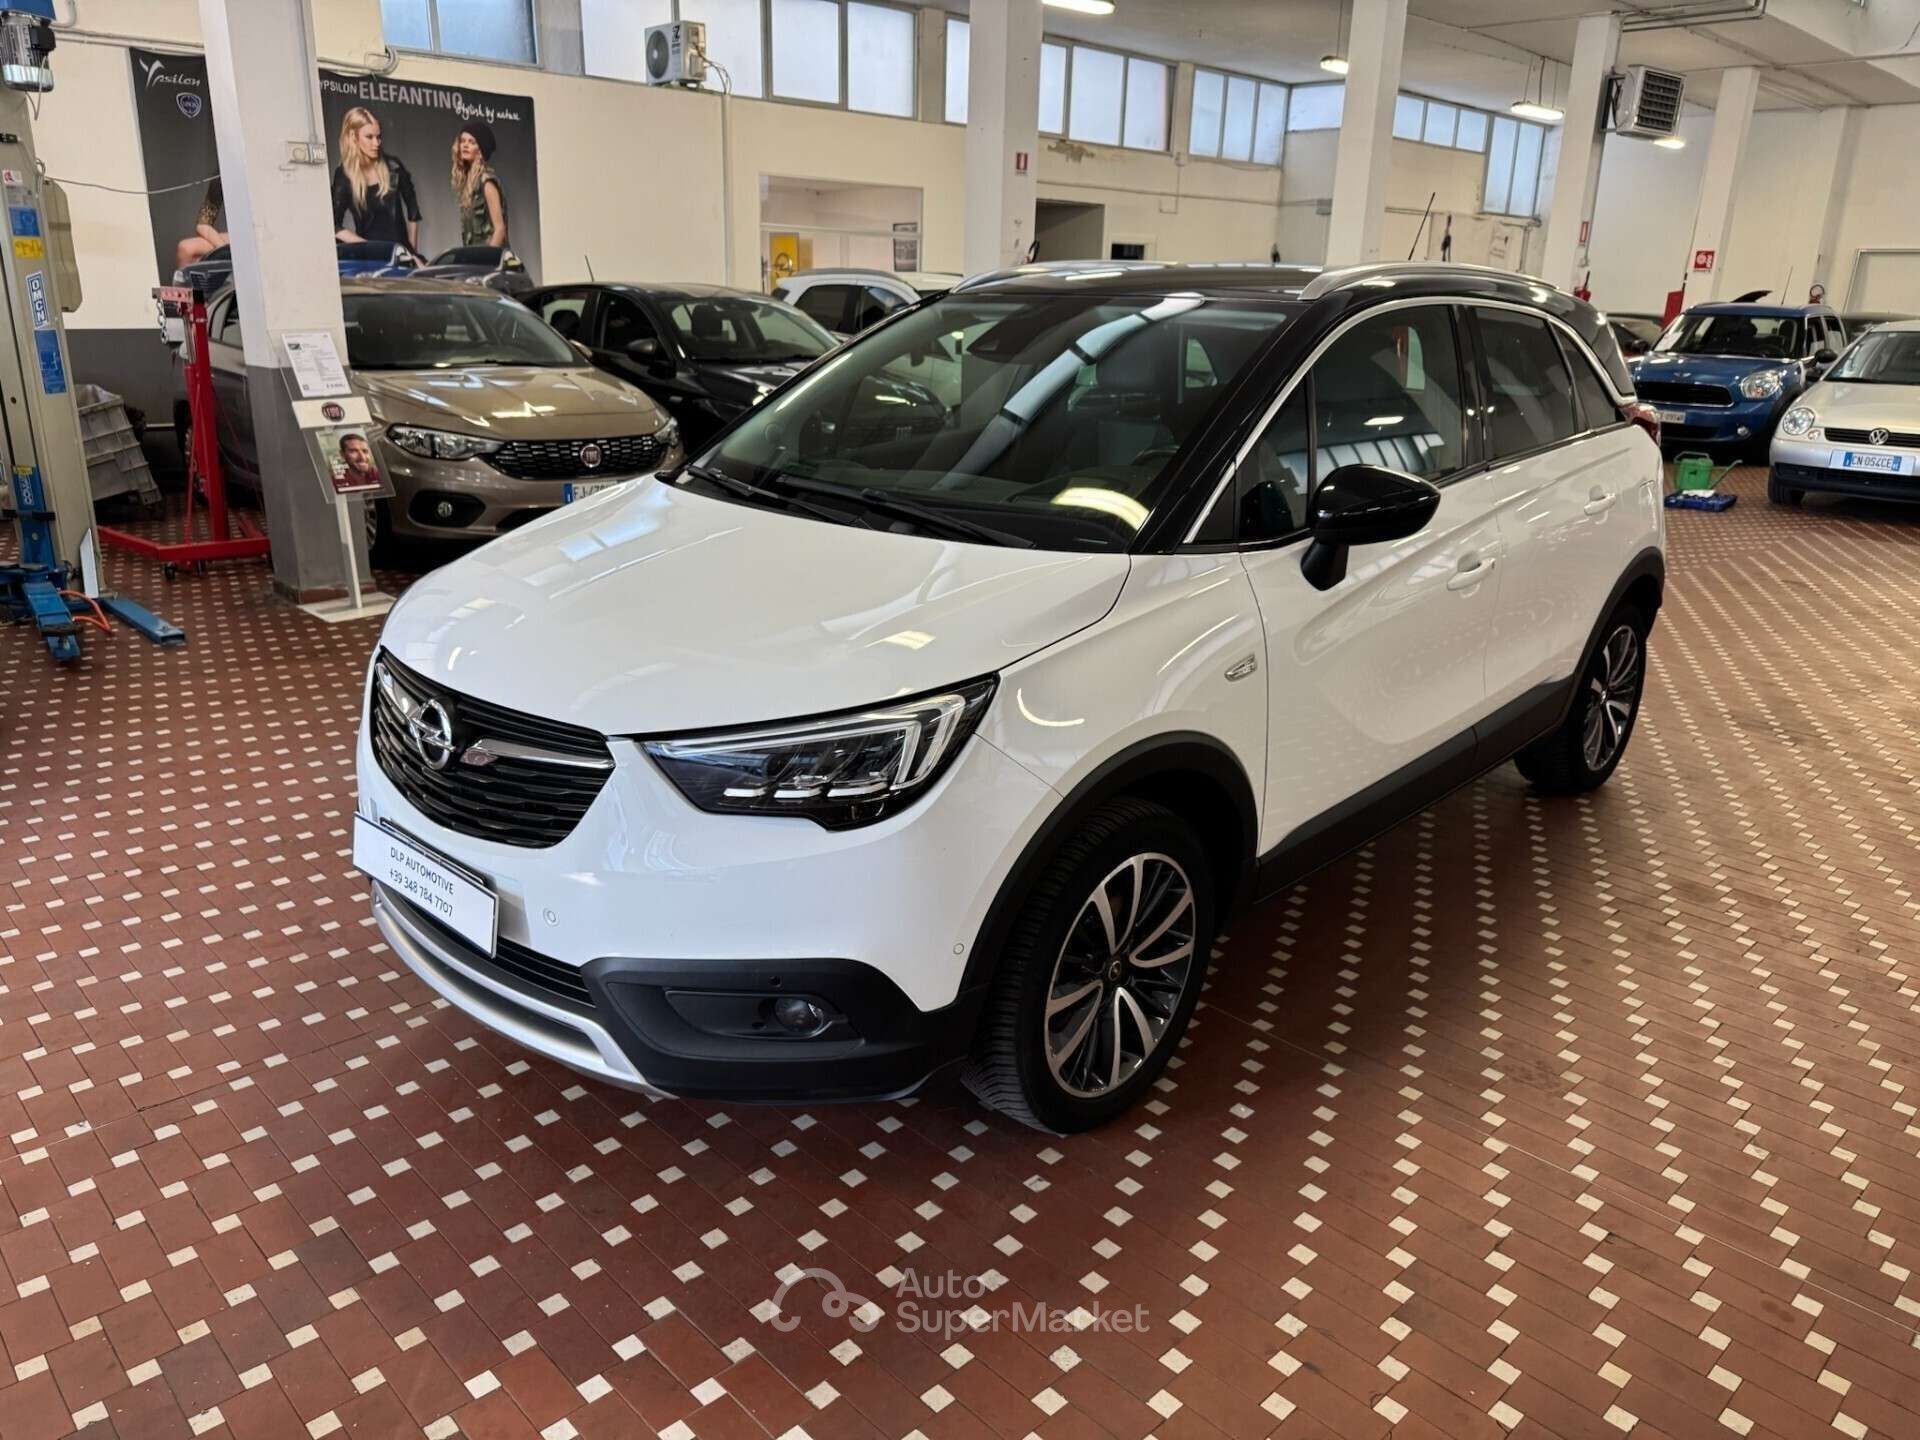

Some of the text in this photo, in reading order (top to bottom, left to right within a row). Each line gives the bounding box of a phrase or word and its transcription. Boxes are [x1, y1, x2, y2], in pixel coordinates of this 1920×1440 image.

[359, 81, 463, 109] ELEFANTINO
[389, 868, 403, 884] +39
[404, 876, 418, 894] 348
[435, 895, 454, 917] 7707
[390, 847, 454, 895] DLP AUTOMOTIVE
